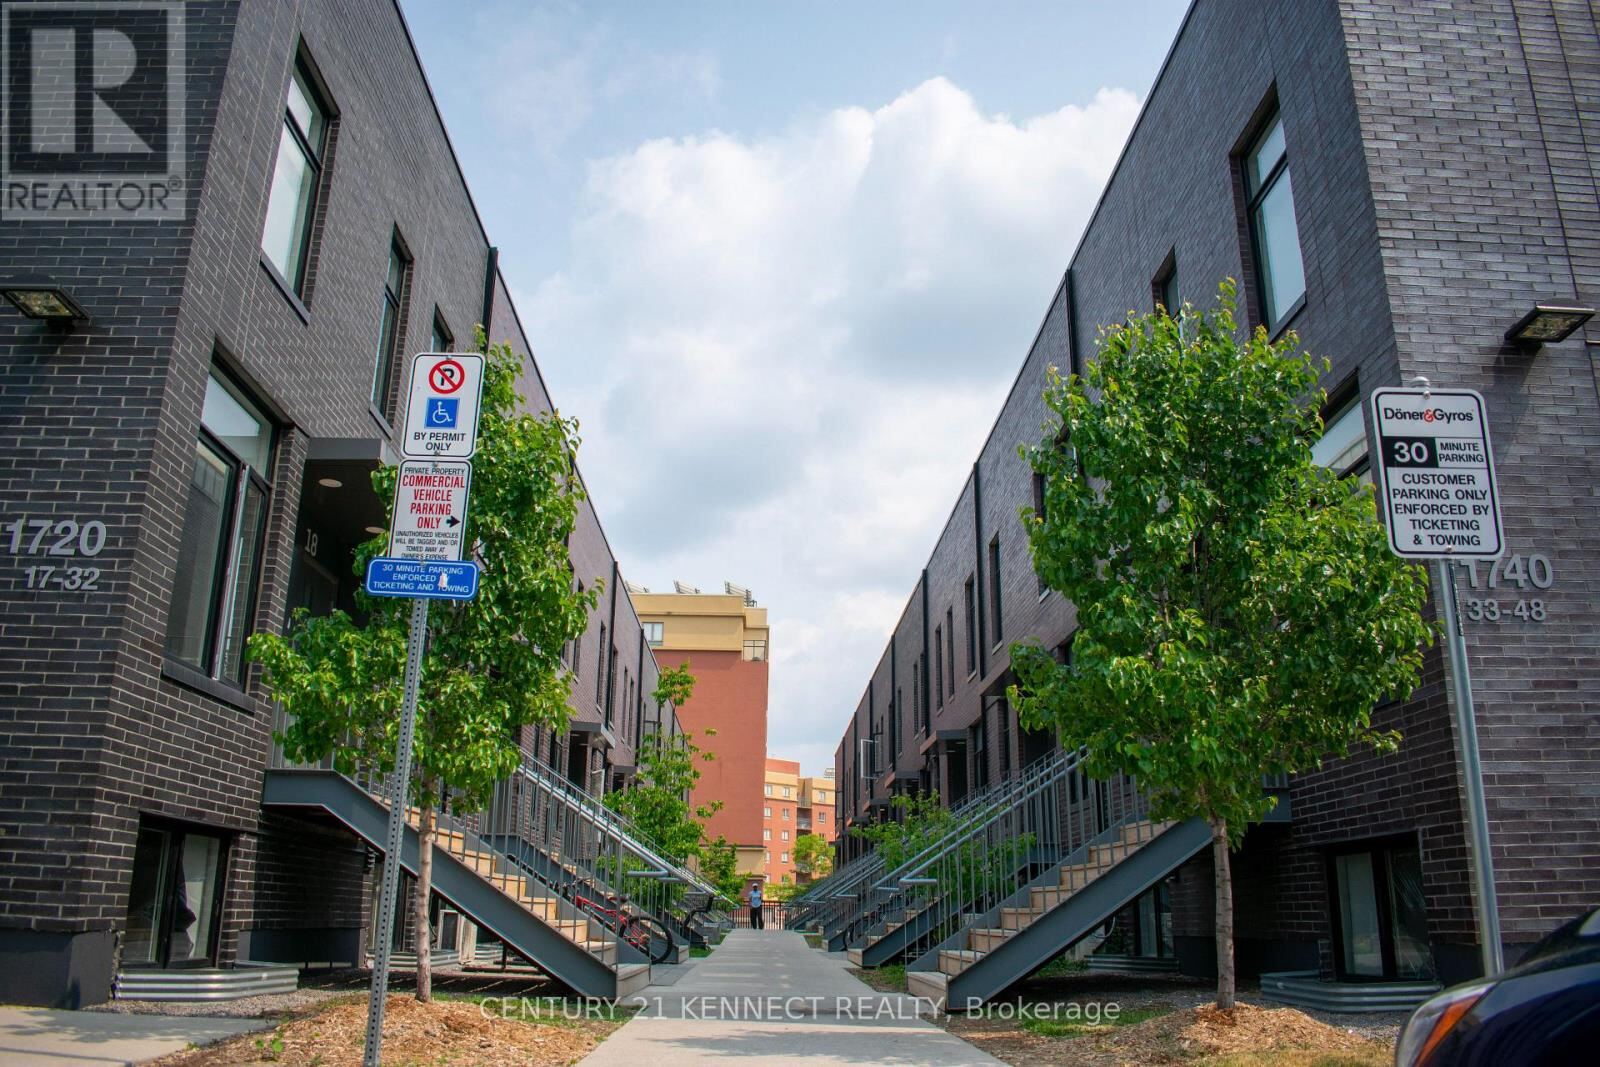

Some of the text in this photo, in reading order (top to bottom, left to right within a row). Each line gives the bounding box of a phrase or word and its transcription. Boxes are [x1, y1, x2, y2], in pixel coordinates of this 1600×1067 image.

[413, 431, 466, 442] BY PERMIT
[425, 441, 452, 451] ONLY
[1394, 441, 1480, 463] 30 MINUTE
[1438, 453, 1484, 463] PARKING
[404, 466, 466, 476] PRIVATE PROPERTY
[402, 474, 466, 489] COMMERCIAL
[1402, 473, 1476, 485] CUSTOMER
[413, 488, 453, 502] VEHICLE
[1392, 488, 1488, 501] PARKING ONLY
[410, 502, 452, 516] PARKING
[1394, 503, 1489, 515] ENFORCED BY
[417, 516, 442, 530] ONLY
[1409, 518, 1480, 531] TICKETING
[5, 518, 107, 557] 1720
[395, 530, 434, 538] UNAUTHORIZED
[1413, 534, 1481, 546] & TOWING
[305, 527, 318, 557] 18
[382, 564, 464, 575] 30 MINUTE PARKING
[1459, 553, 1554, 590] 1740
[24, 565, 100, 591] 17-32
[392, 573, 437, 582] ENFORCED
[373, 581, 415, 590] TICKETING
[417, 583, 435, 591] AND
[1466, 598, 1547, 622] 33-48
